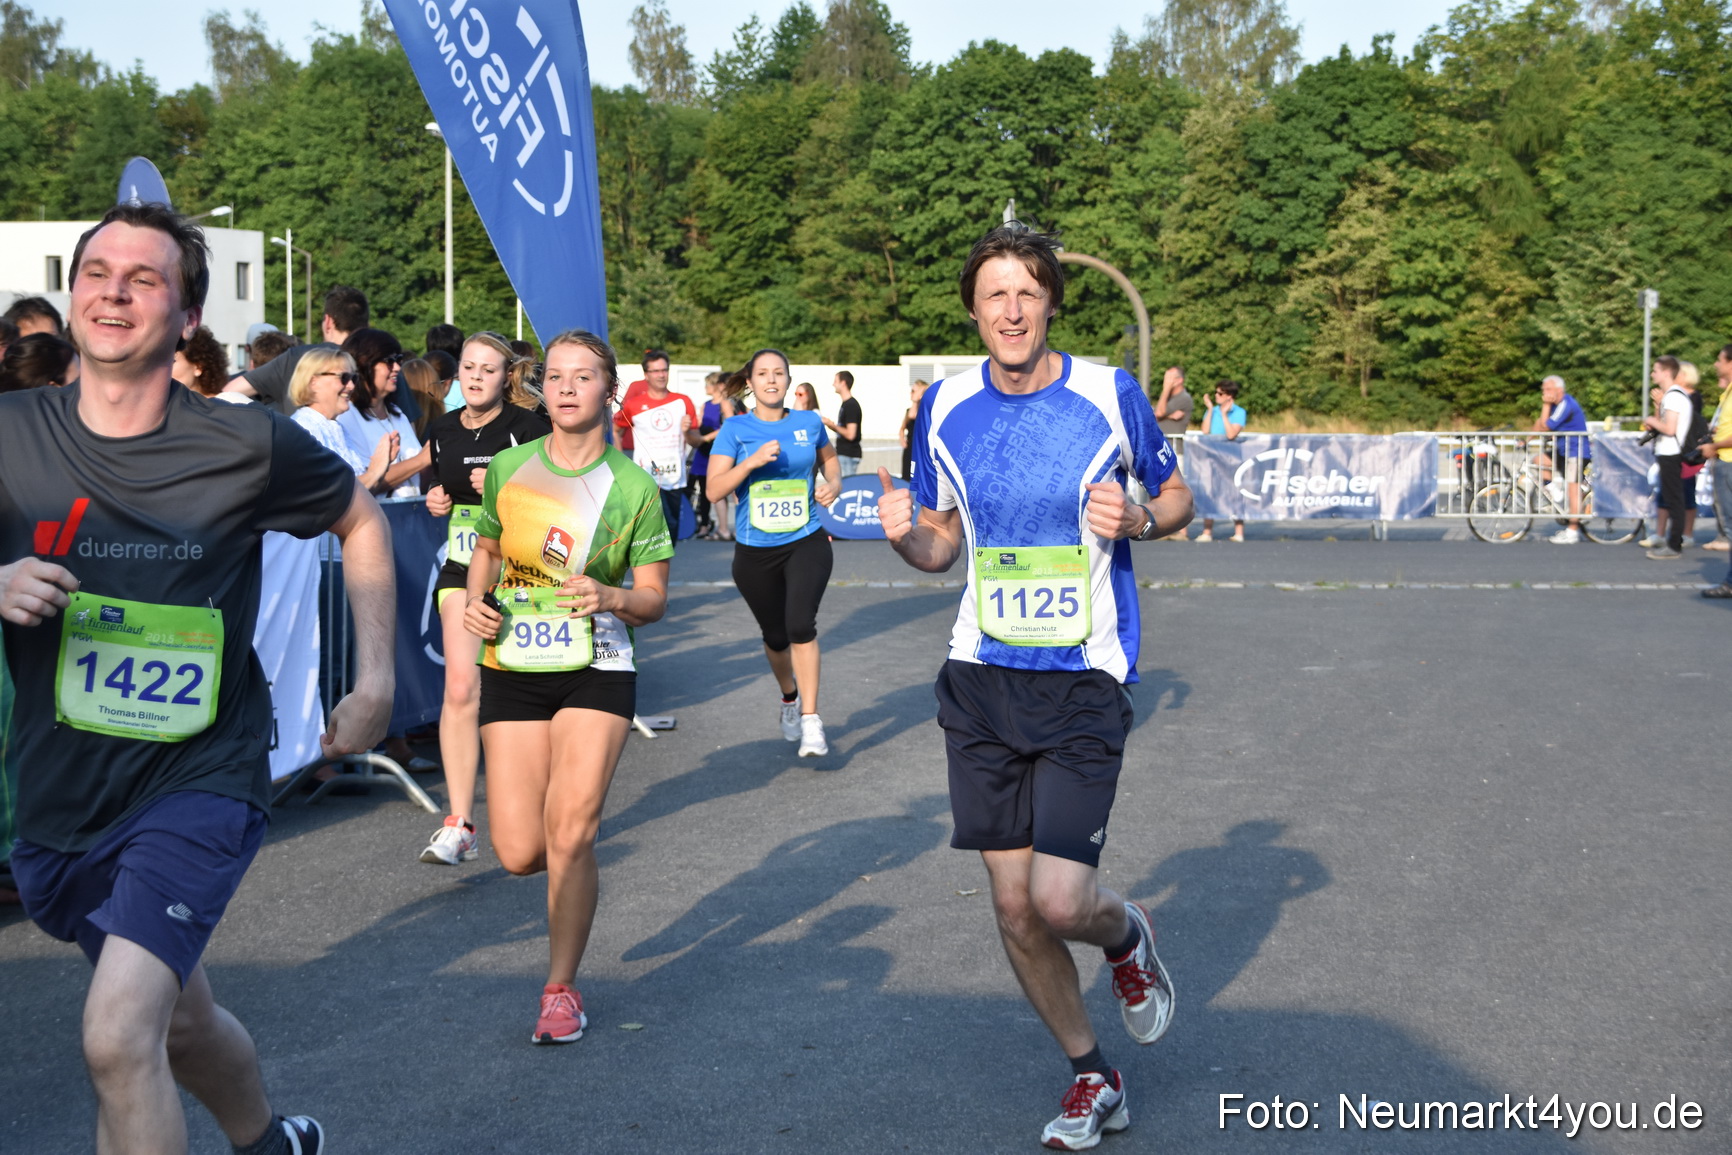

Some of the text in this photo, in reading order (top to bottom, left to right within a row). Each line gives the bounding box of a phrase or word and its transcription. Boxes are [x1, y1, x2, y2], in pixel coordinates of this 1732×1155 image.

[1260, 469, 1385, 494] Fischer
[757, 500, 803, 518] 1285
[1271, 495, 1375, 507] AUTOMOBILE
[78, 537, 204, 561] duerrer.de
[508, 557, 564, 588] Neuma
[993, 563, 1031, 571] firmenlauf
[989, 587, 1079, 619] 1125
[88, 617, 145, 635] firmenlauf
[514, 621, 573, 648] 984
[144, 632, 175, 644] 2015
[76, 651, 205, 706] 1422
[98, 705, 171, 722] Thomas Billner
